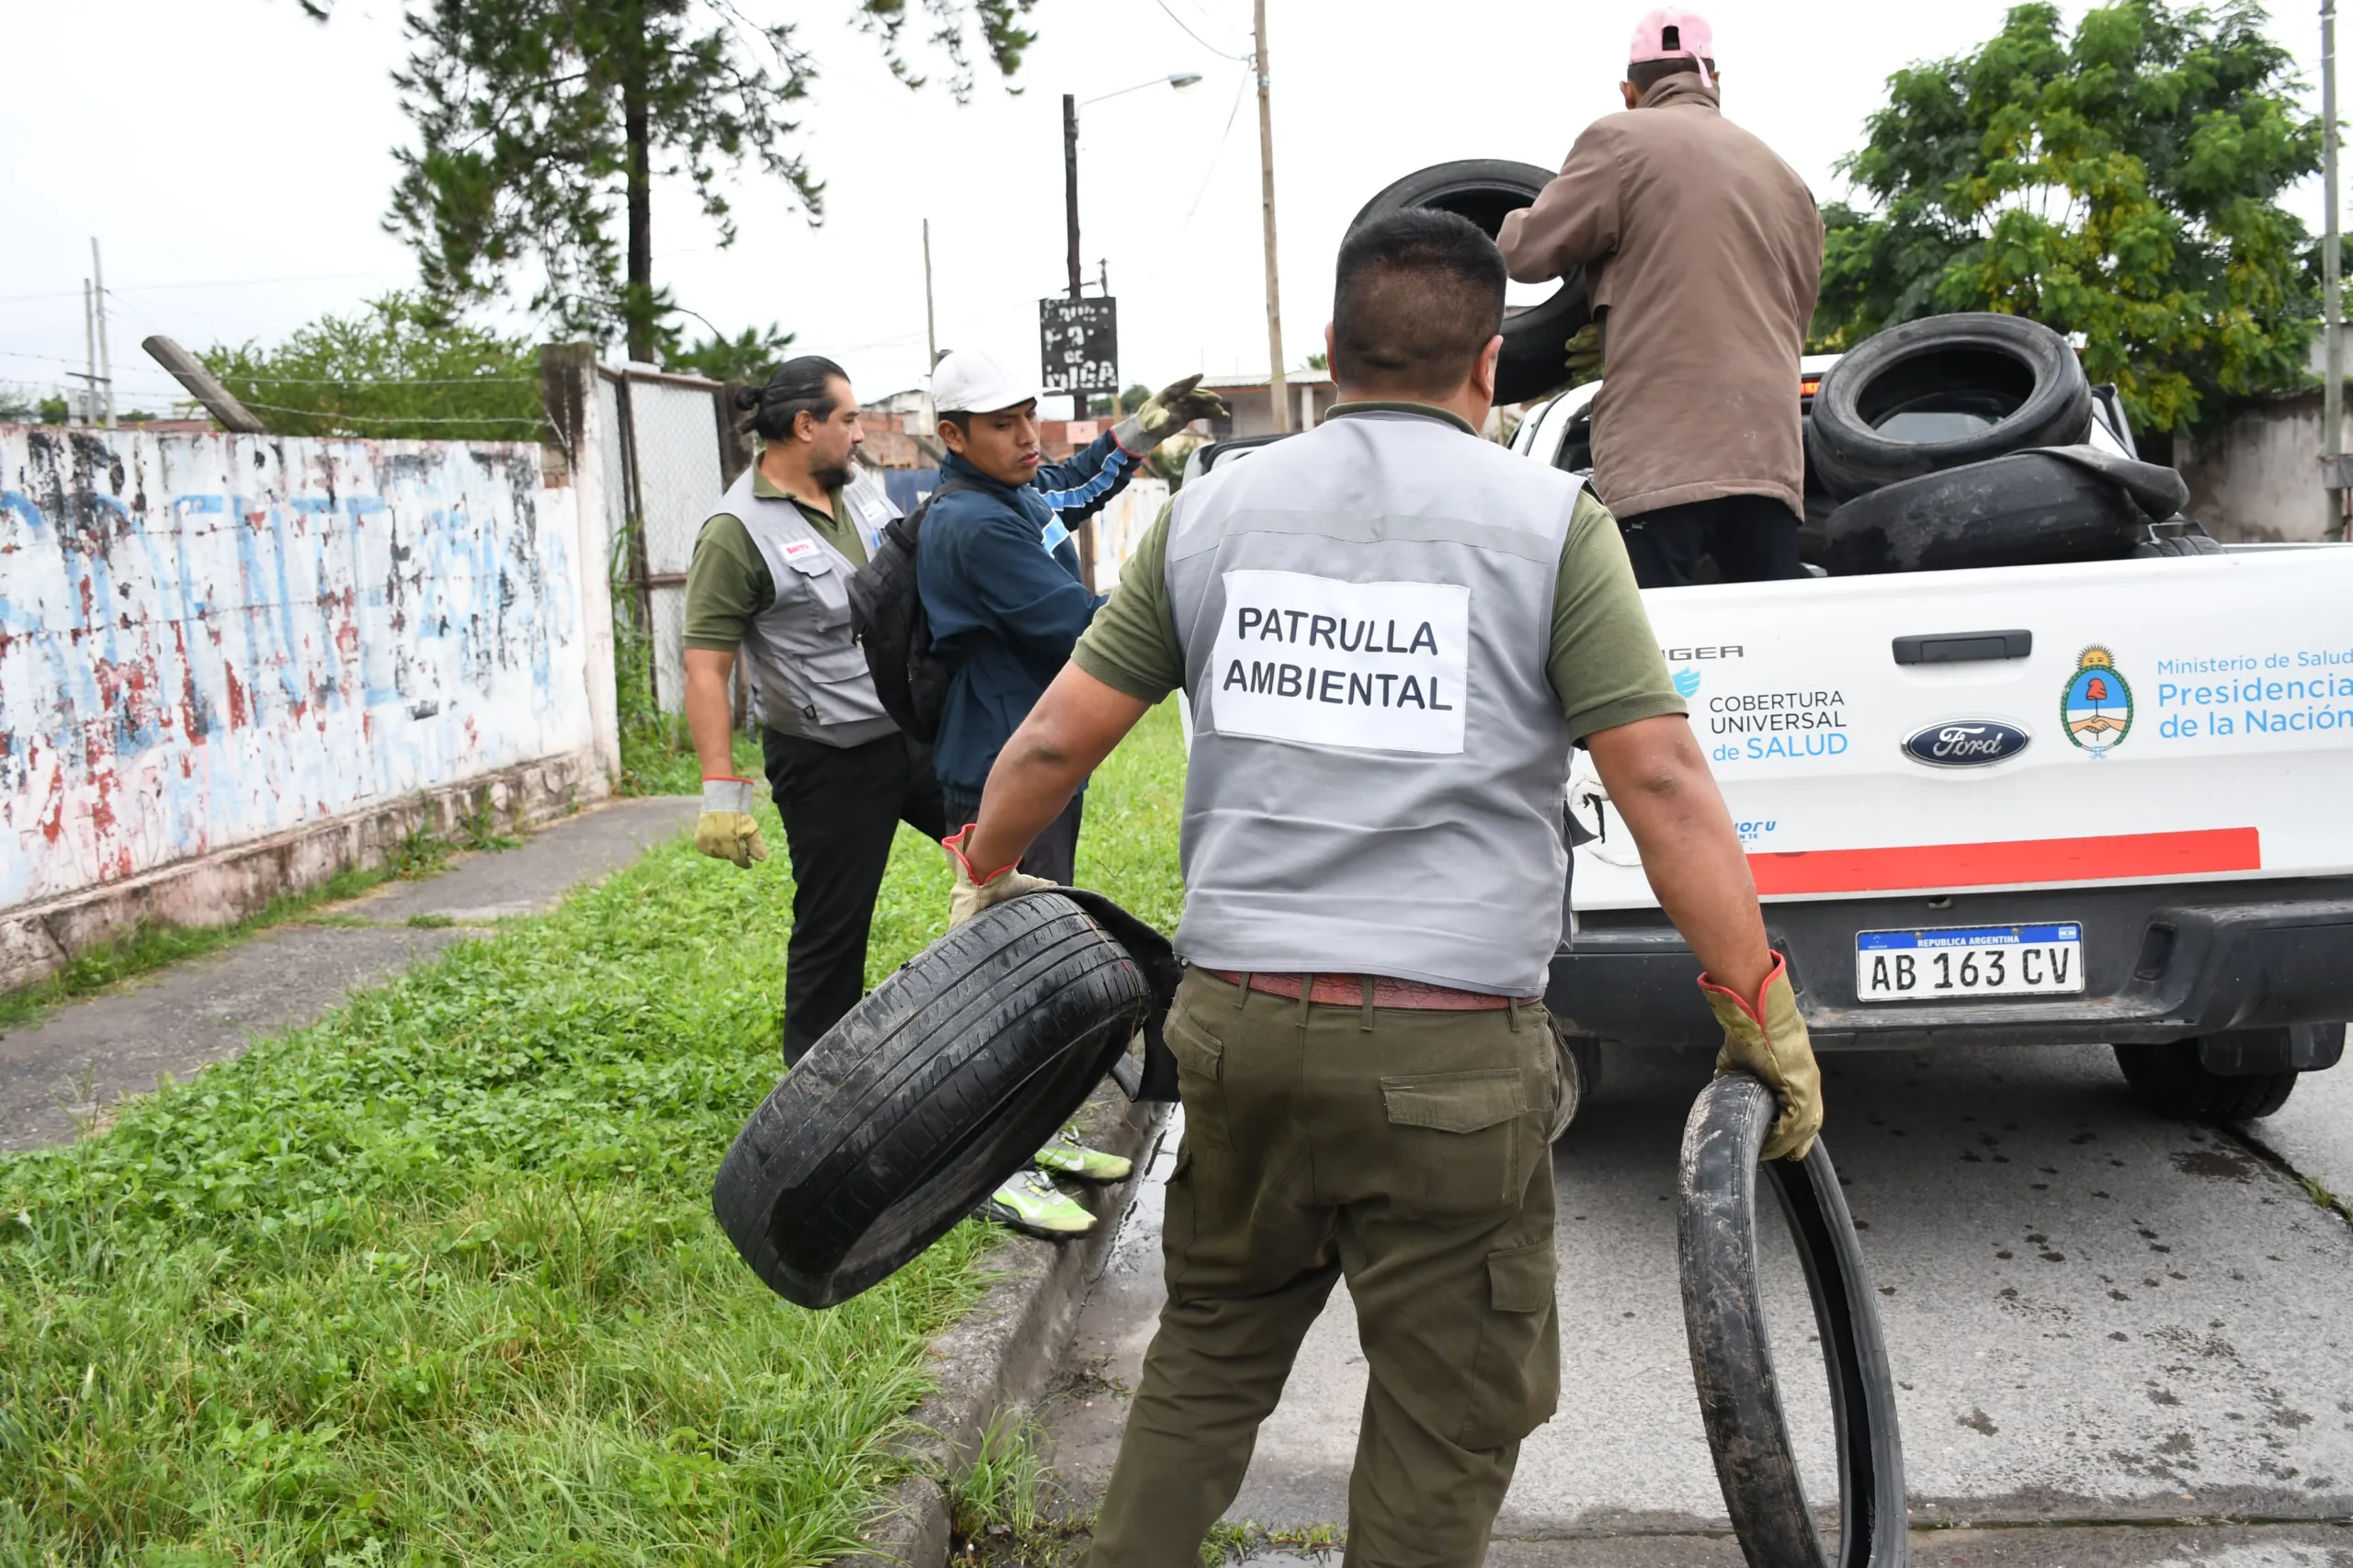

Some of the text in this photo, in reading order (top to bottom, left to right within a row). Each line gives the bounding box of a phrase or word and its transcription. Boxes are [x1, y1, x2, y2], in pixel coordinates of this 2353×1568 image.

[1238, 607, 1438, 656] PATRULLA
[2157, 648, 2353, 676] Ministerio de Salud
[1222, 659, 1453, 711] AMBIENTAL
[2158, 672, 2353, 708] Presidencia
[1710, 690, 1845, 713] COBERTURA
[1711, 710, 1847, 734] UNIVERSAL
[2159, 703, 2353, 739] de la Nación
[1712, 733, 1848, 761] de SALUD
[1932, 726, 2004, 756] Ford
[1917, 935, 2020, 949] REPUBLICA ARGENTINA
[1871, 947, 2070, 991] AB 163 CV
